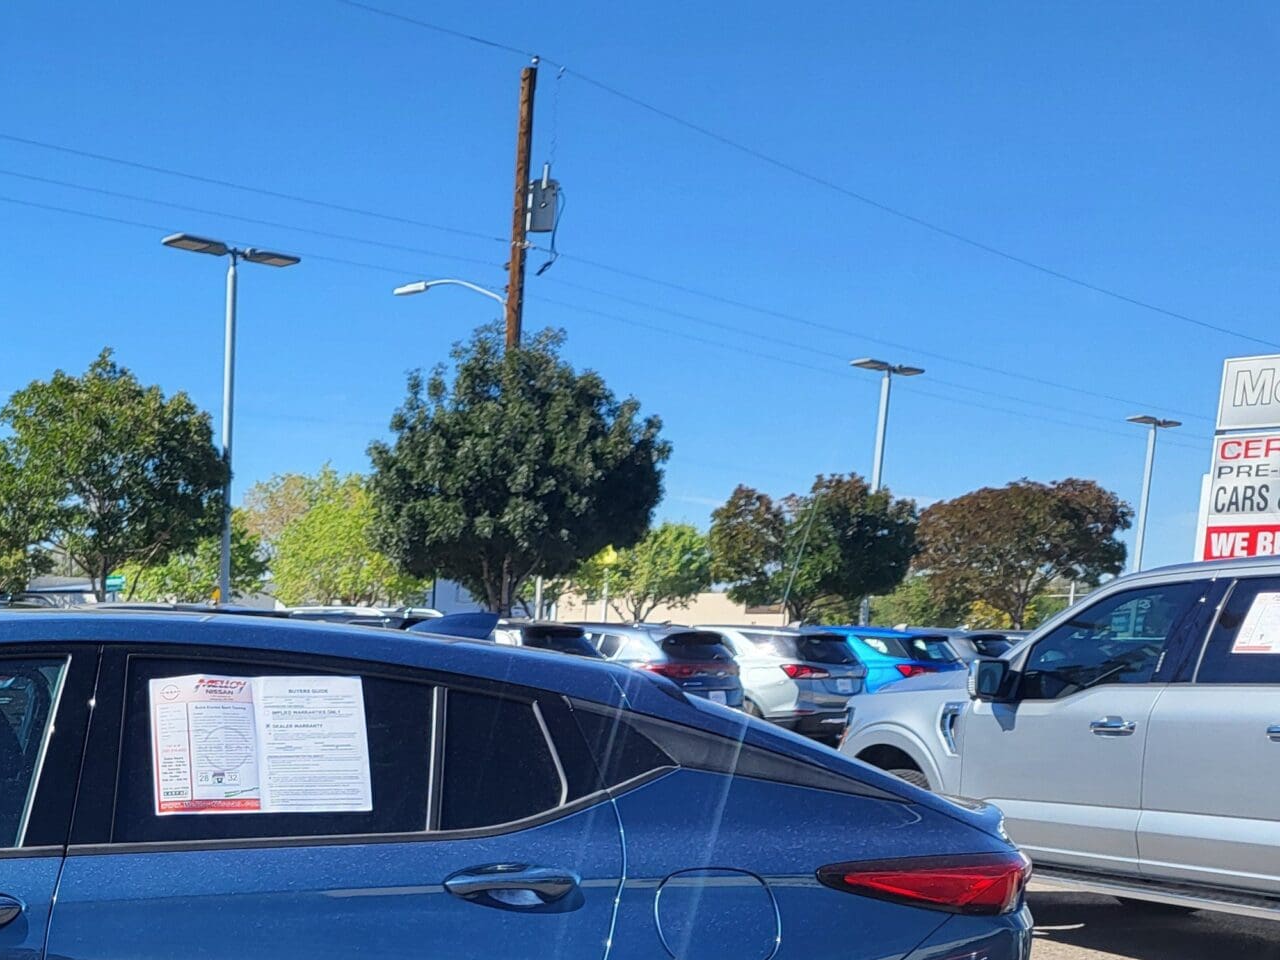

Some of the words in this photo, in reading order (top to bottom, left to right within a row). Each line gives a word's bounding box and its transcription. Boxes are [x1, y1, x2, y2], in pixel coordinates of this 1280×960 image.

[1233, 368, 1280, 407] M
[1217, 463, 1280, 479] PRE-
[1214, 484, 1270, 513] CARS
[1211, 531, 1250, 557] WE
[227, 774, 238, 782] 32
